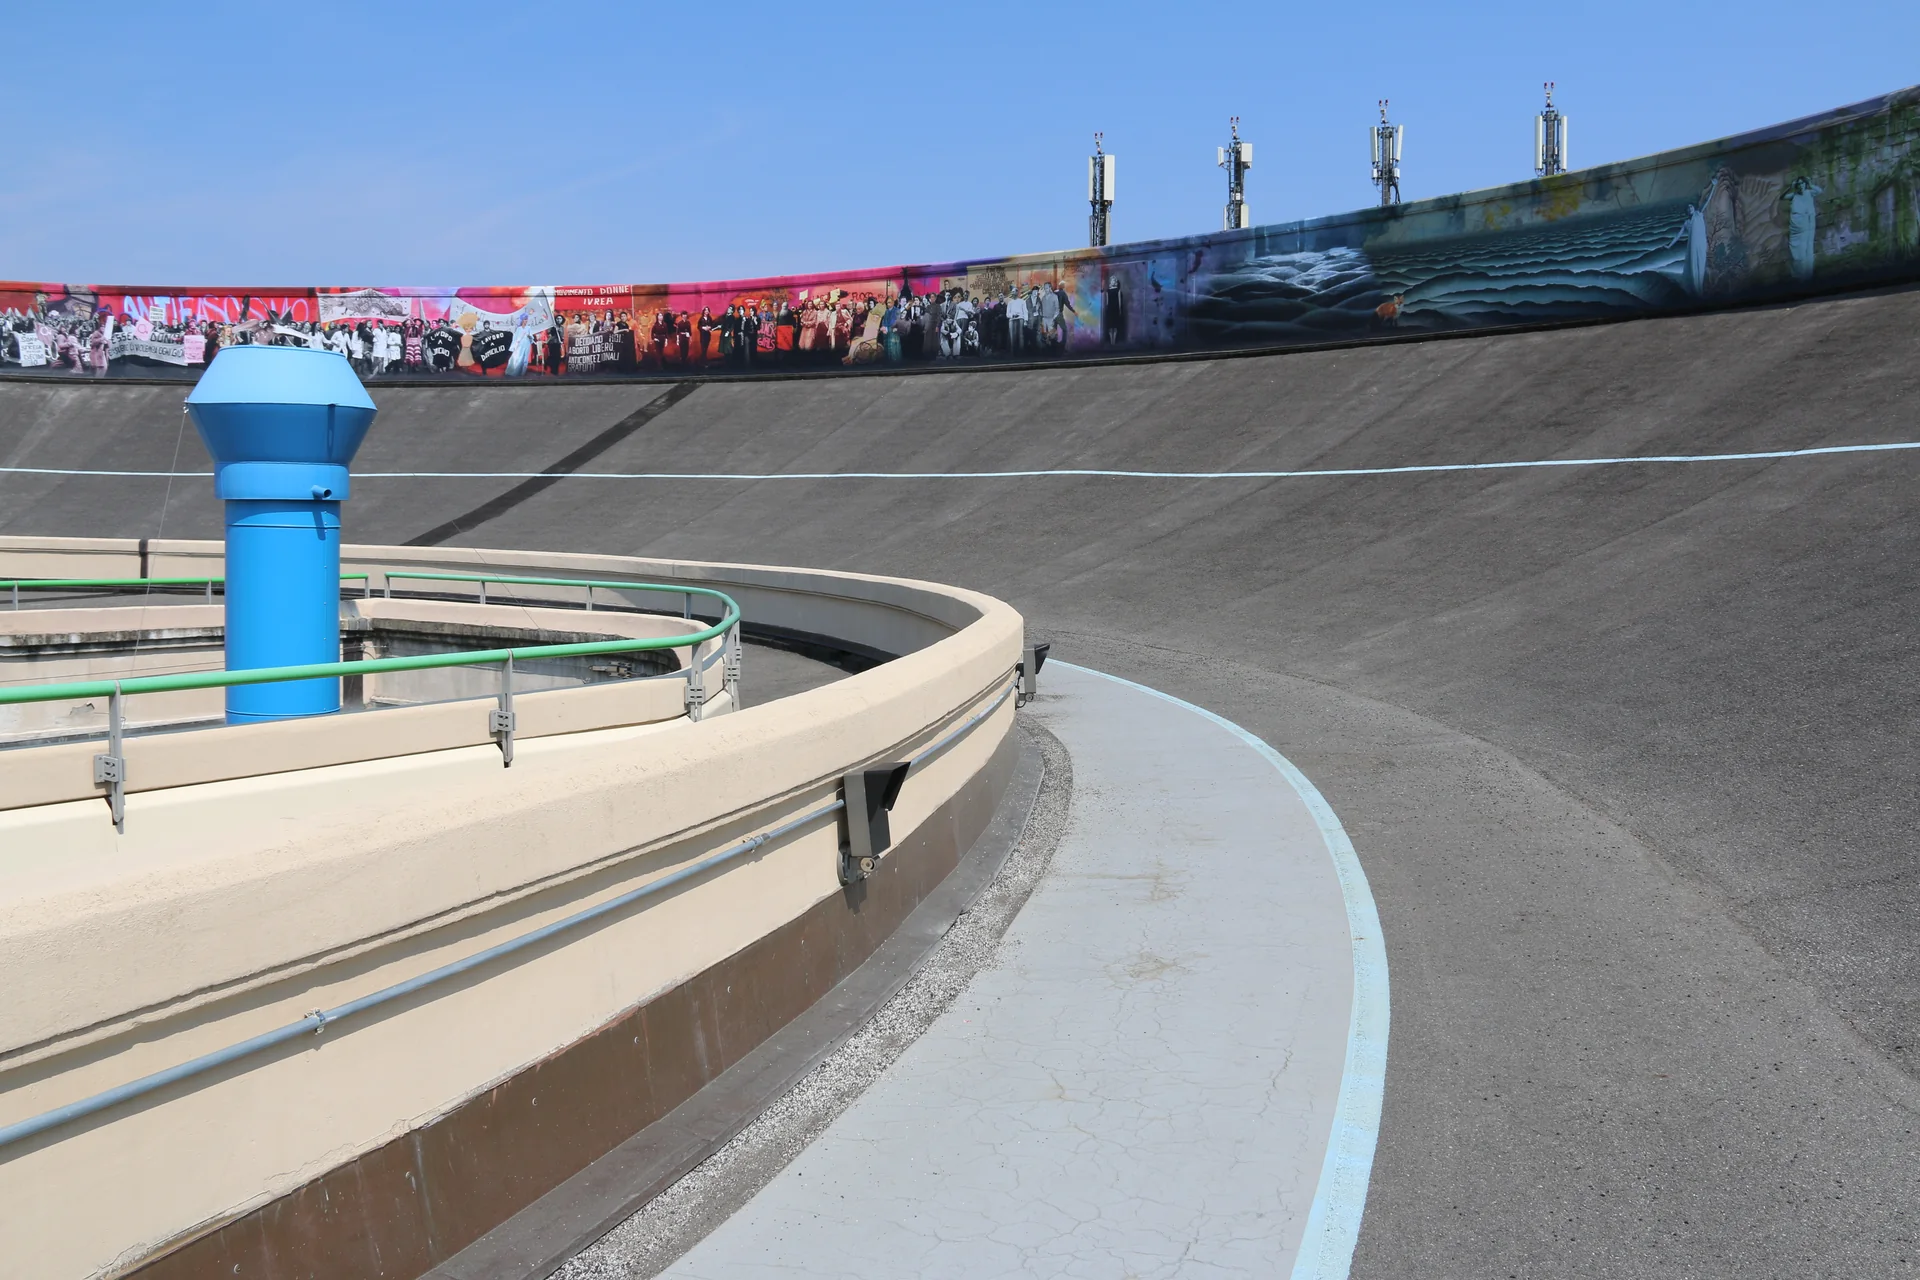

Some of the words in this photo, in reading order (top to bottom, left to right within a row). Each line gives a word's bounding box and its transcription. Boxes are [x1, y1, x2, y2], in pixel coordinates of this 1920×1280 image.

[555, 288, 593, 296] MOVIMENTO
[600, 285, 630, 295] DONNE
[583, 297, 614, 306] IVREA
[123, 294, 310, 325] ANTIFASCSMO
[481, 332, 504, 345] LAVORO
[568, 346, 590, 355] ABORTO
